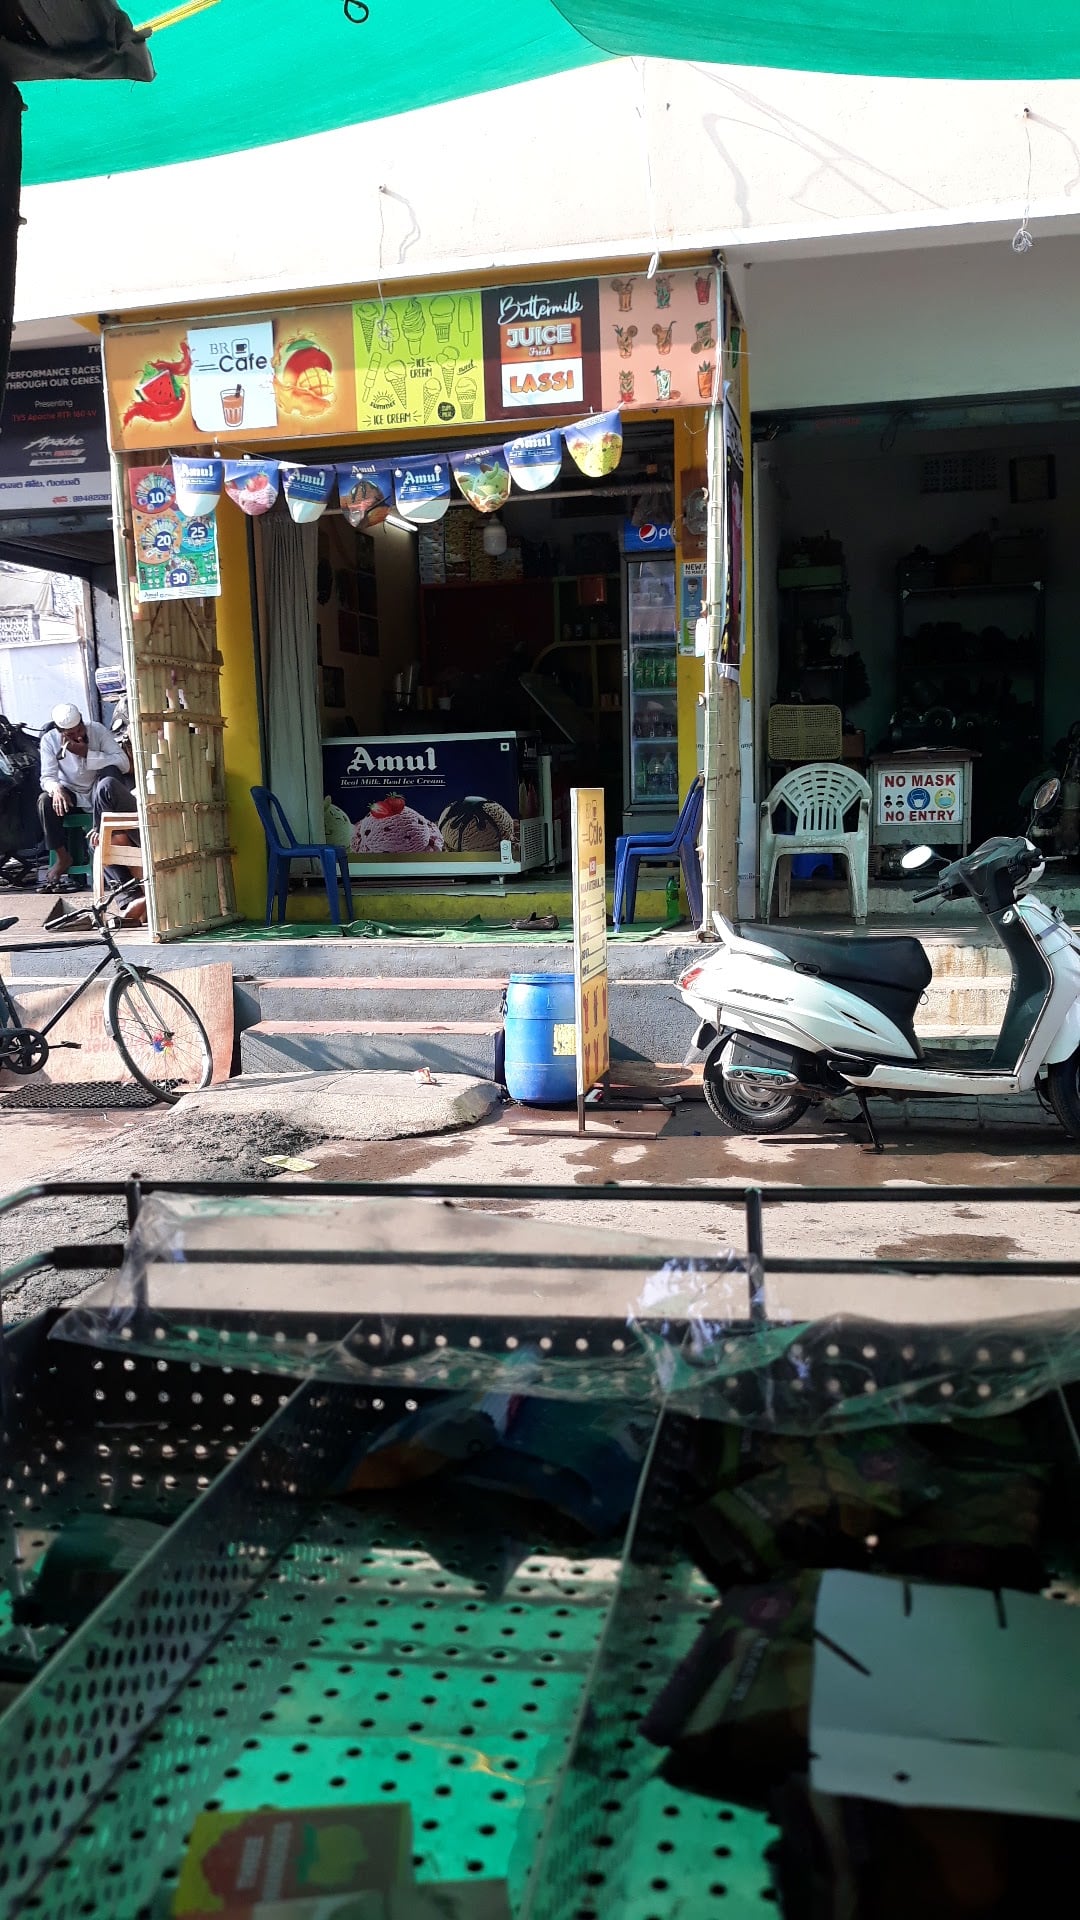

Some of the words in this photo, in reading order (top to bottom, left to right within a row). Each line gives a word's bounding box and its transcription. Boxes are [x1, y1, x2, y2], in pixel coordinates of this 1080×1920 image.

[498, 291, 583, 325] Buttermilk
[506, 323, 573, 348] JUICE
[88, 345, 102, 353] TV
[528, 346, 552, 356] Fresh
[219, 353, 268, 372] Cafe
[416, 358, 425, 368] ICE
[7, 367, 70, 379] PERFORMANCE
[72, 365, 101, 375] RACES
[410, 368, 432, 378] CREAM
[5, 380, 48, 390] THROUGH
[49, 378, 69, 387] OUR
[70, 376, 102, 385] GENES.
[509, 370, 575, 394] LASSI
[34, 400, 73, 408] Presenting
[373, 415, 384, 425] ICE
[386, 413, 411, 424] CREAM
[22, 434, 84, 450] Apache
[511, 433, 551, 450] Amul
[181, 463, 214, 478] Amul
[289, 469, 325, 486] Amul
[403, 470, 440, 487] Amul
[150, 492, 164, 504] 10
[190, 527, 205, 538] 25
[156, 535, 172, 547] 20
[172, 572, 187, 584] 30
[347, 746, 437, 775] Amul
[416, 777, 446, 785] Cream.
[884, 775, 906, 787] NO
[911, 773, 956, 787] MASK
[885, 811, 905, 822] NO
[909, 810, 955, 822] ENTRY
